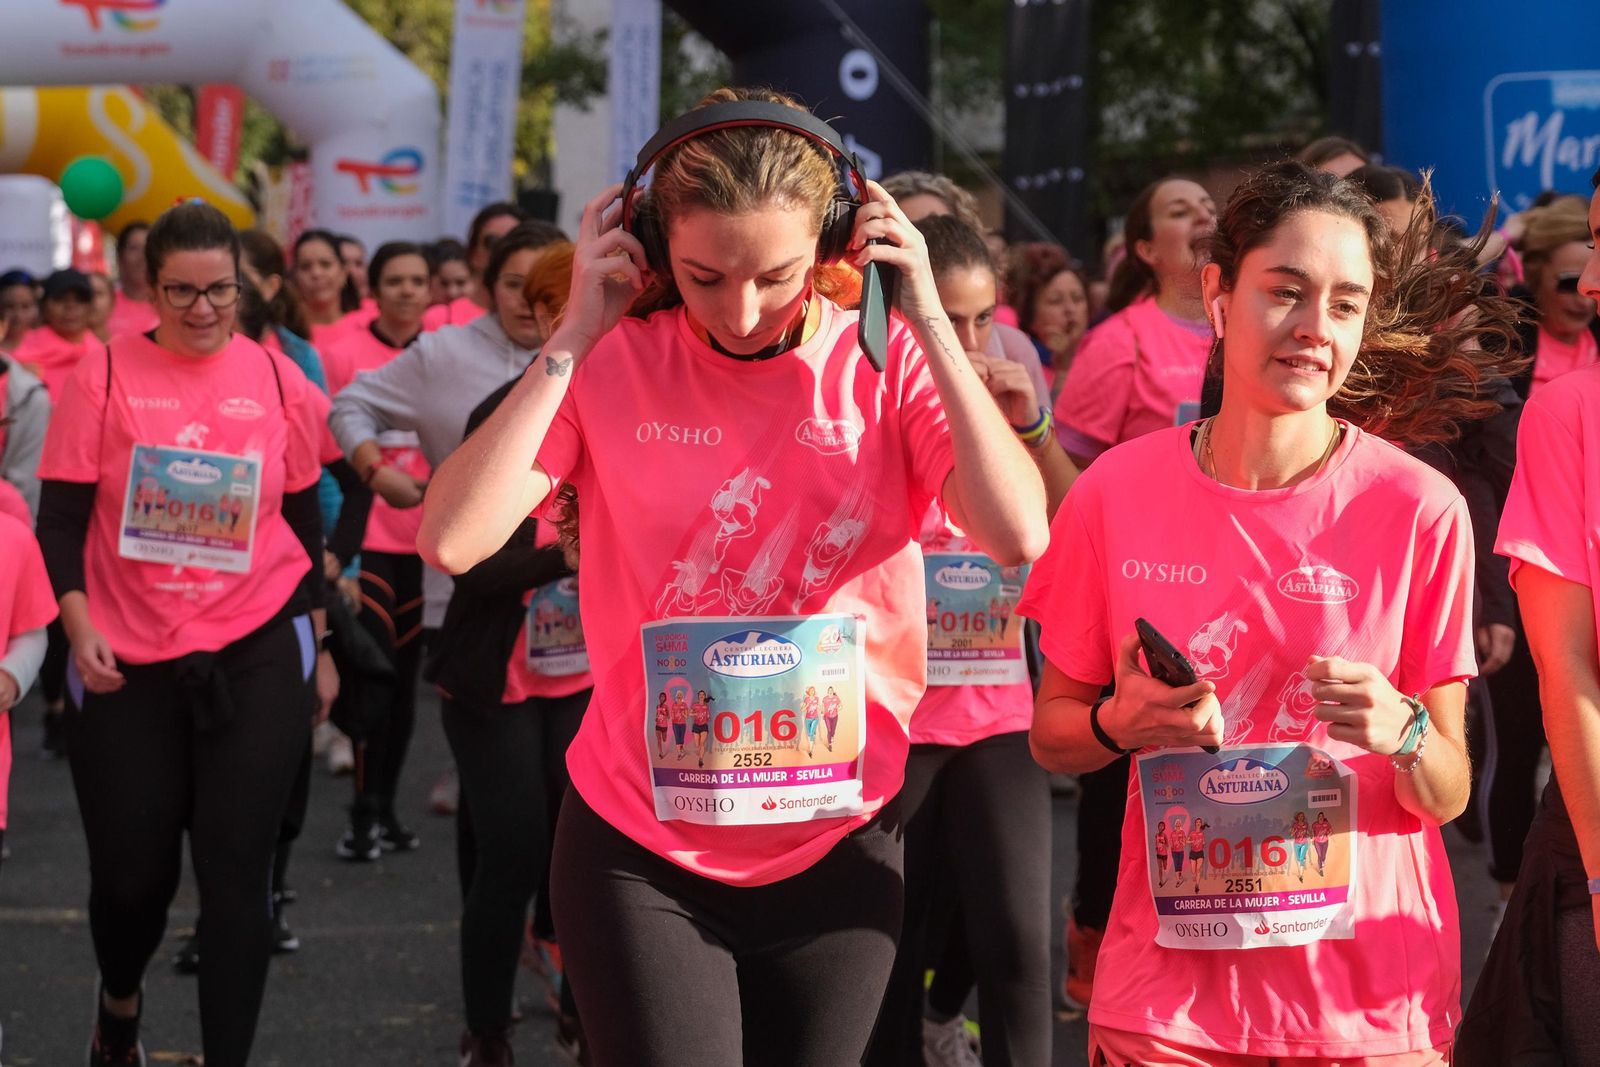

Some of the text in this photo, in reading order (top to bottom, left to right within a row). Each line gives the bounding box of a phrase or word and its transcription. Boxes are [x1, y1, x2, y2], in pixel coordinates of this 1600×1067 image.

[636, 421, 722, 445] OYSHO
[168, 499, 215, 522] 016
[1122, 559, 1207, 584] OYSHO
[1283, 577, 1352, 597] ASTURIANA
[940, 611, 985, 633] 016
[656, 641, 688, 652] SUMA
[952, 638, 973, 648] 2001
[709, 649, 795, 667] ASTURIANA
[927, 666, 951, 676] SHO
[713, 708, 798, 744] 016
[733, 752, 773, 767] 2552
[679, 768, 833, 784] CARRERA DE LA MUJER SEVILLA
[1205, 776, 1283, 795] ASTURIANA
[674, 795, 735, 813] OYSHO
[779, 793, 838, 810] Santander
[1208, 835, 1288, 870] 016
[1225, 878, 1262, 893] 2551
[1175, 892, 1327, 911] CARRERA DE LA MUJER SEVILLA
[1175, 922, 1228, 938] OYSHO
[1272, 917, 1328, 934] Santander
